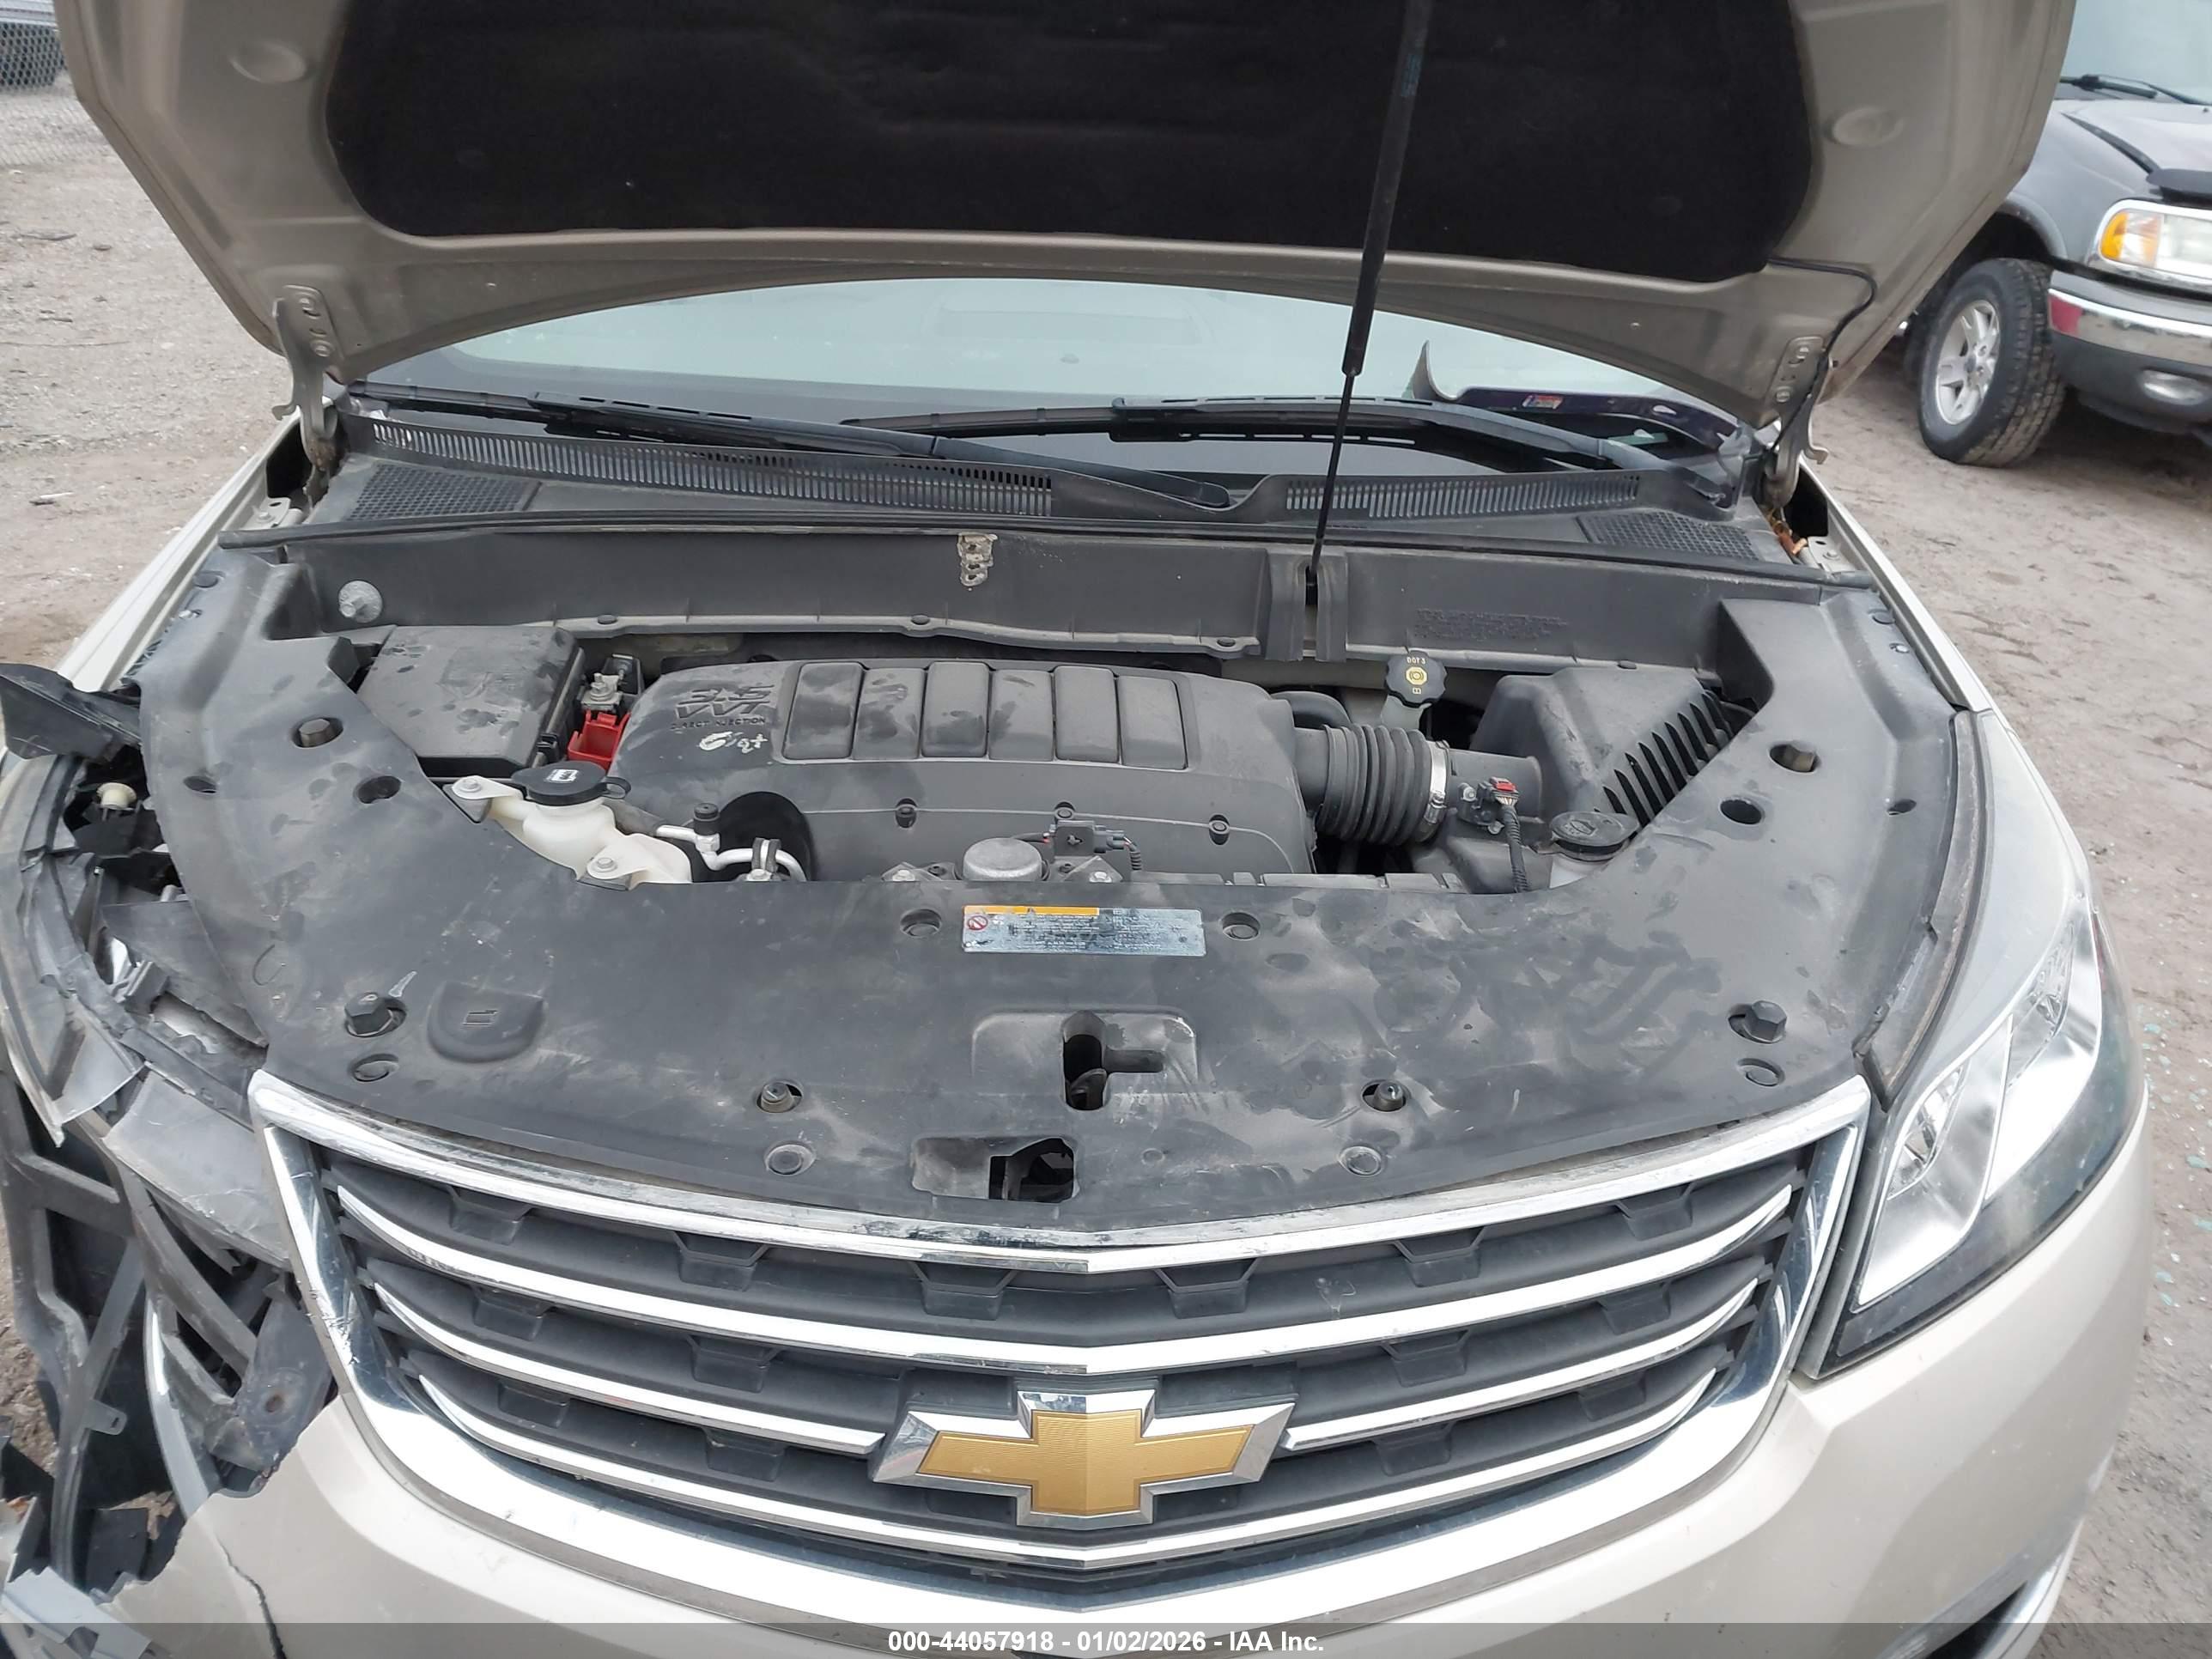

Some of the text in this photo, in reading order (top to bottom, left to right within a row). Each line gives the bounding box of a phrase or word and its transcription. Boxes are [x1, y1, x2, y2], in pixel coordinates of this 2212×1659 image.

[677, 701, 770, 719] VVT
[670, 717, 766, 730] DRECT NJECTON
